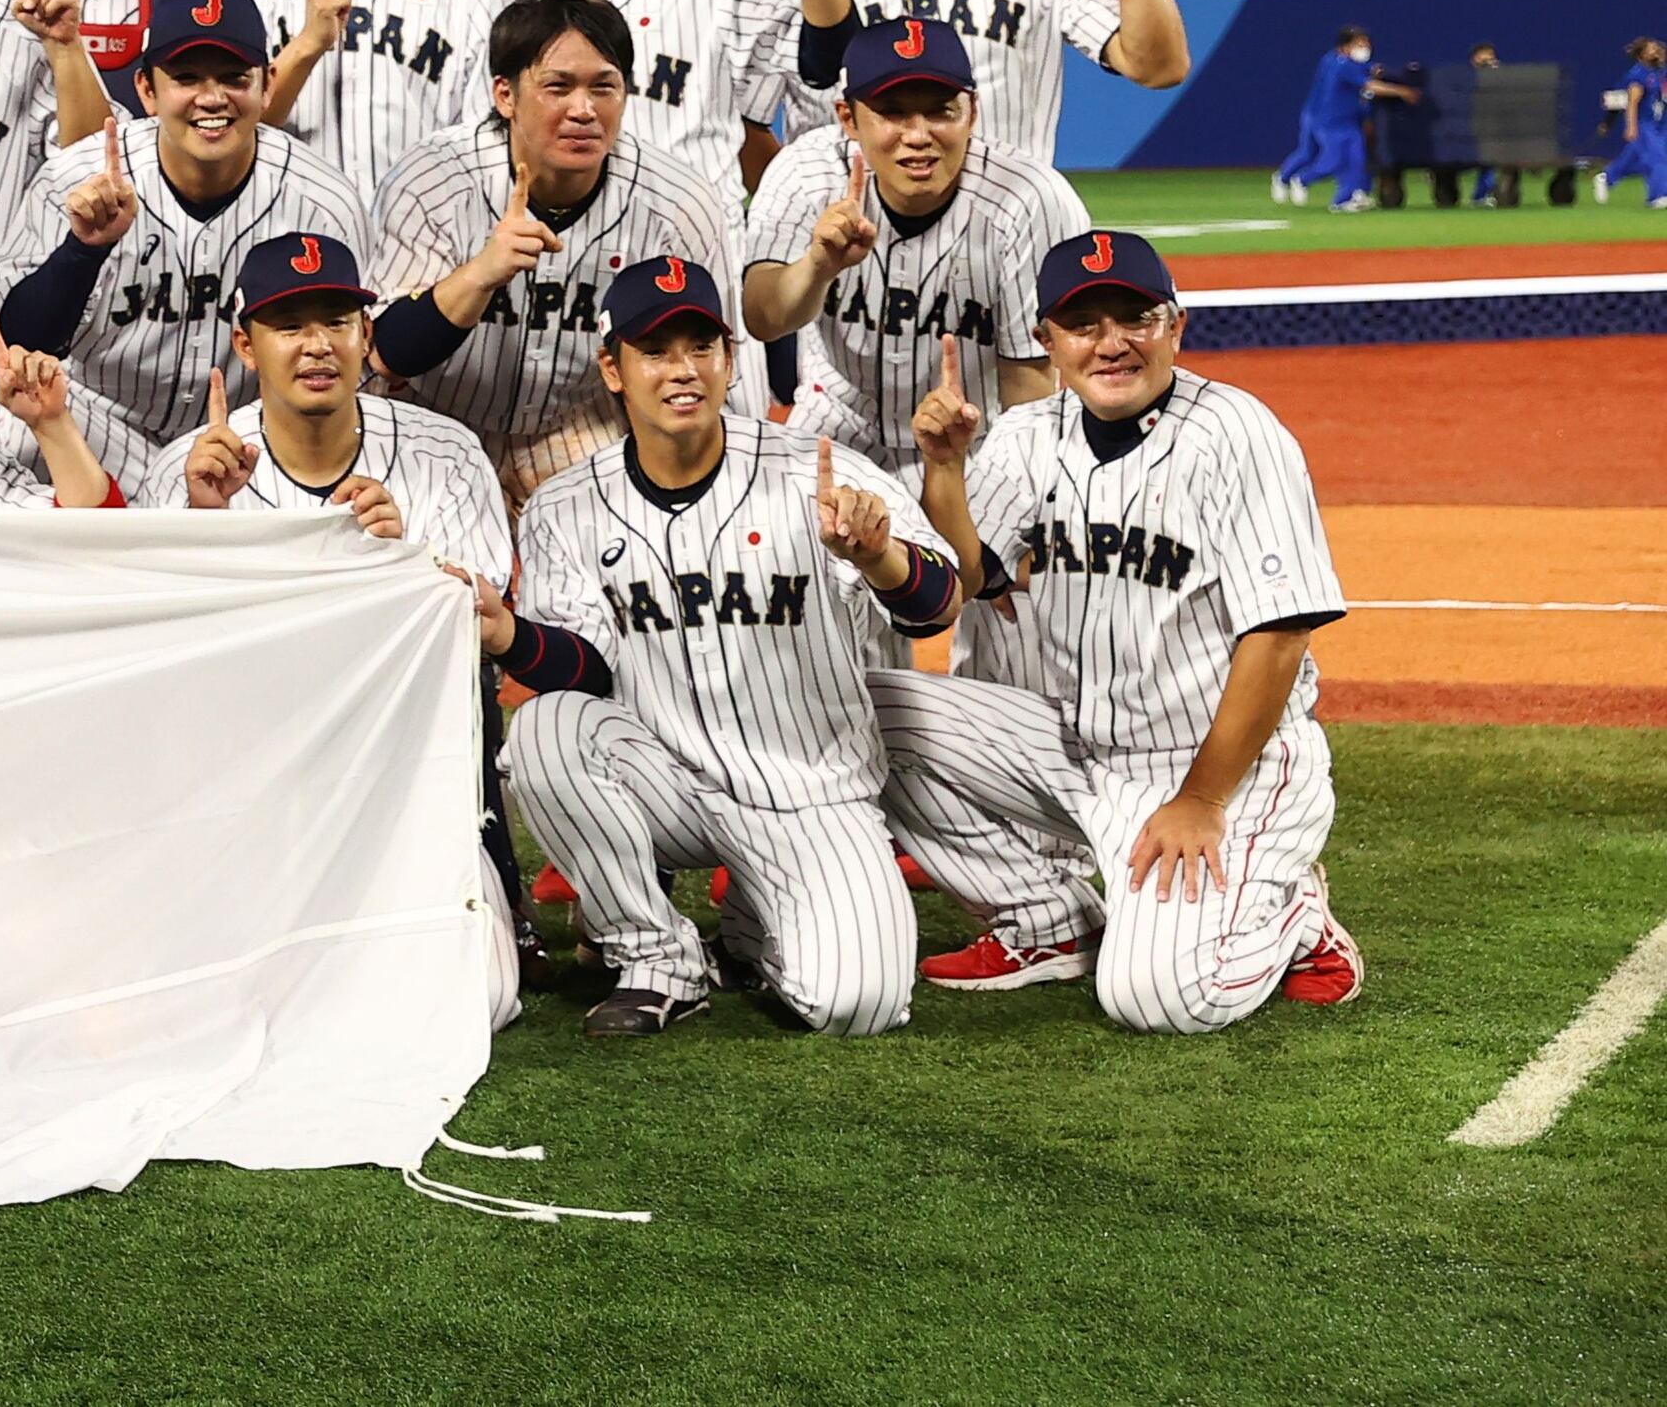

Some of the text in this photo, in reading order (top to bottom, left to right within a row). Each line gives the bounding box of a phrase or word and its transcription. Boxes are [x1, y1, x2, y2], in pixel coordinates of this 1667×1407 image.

[893, 20, 925, 59] J
[290, 236, 322, 275] J
[1081, 233, 1114, 273] J
[654, 256, 687, 293] J
[112, 272, 232, 326] JAP
[480, 282, 598, 334] APA
[1030, 520, 1194, 592] JAPAN
